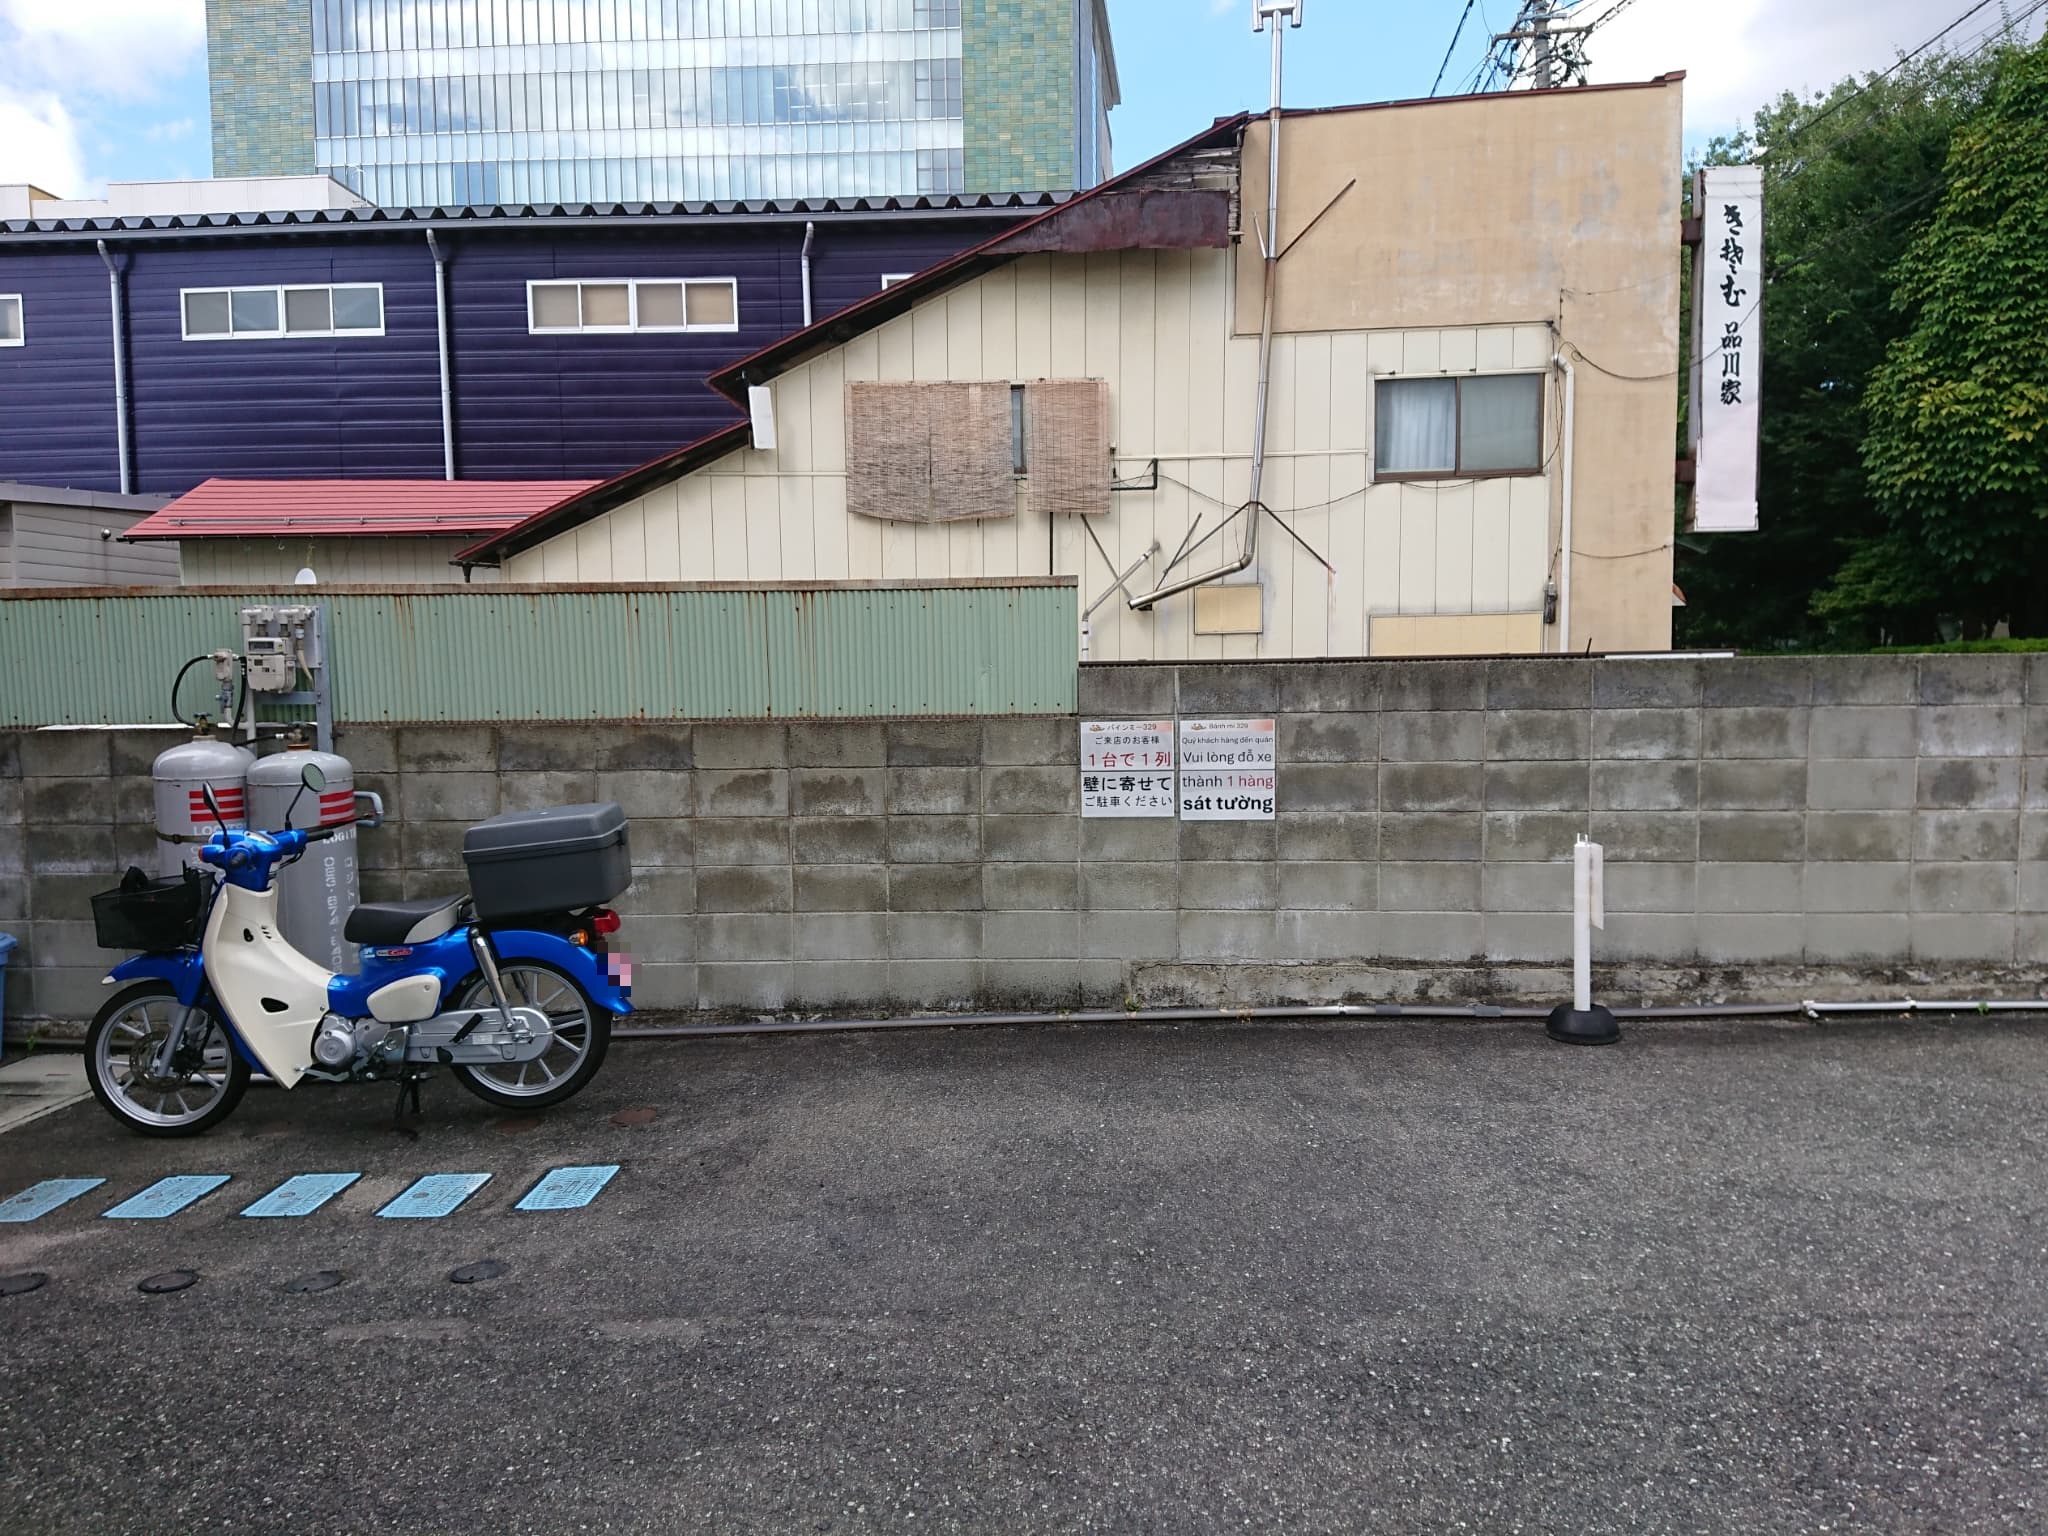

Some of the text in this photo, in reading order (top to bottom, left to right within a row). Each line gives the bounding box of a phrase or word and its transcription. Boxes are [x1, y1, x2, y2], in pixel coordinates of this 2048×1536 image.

[1720, 321, 1742, 406] 品川家
[1095, 736, 1160, 745] ご来店のお客様
[1183, 748, 1272, 765] Vui lòng đỗ xe
[1083, 775, 1172, 792] 壁に寄せて
[1182, 774, 1274, 790] thành 1 hàng
[1084, 795, 1173, 807] ご駐車ください
[1183, 794, 1273, 814] sát tường
